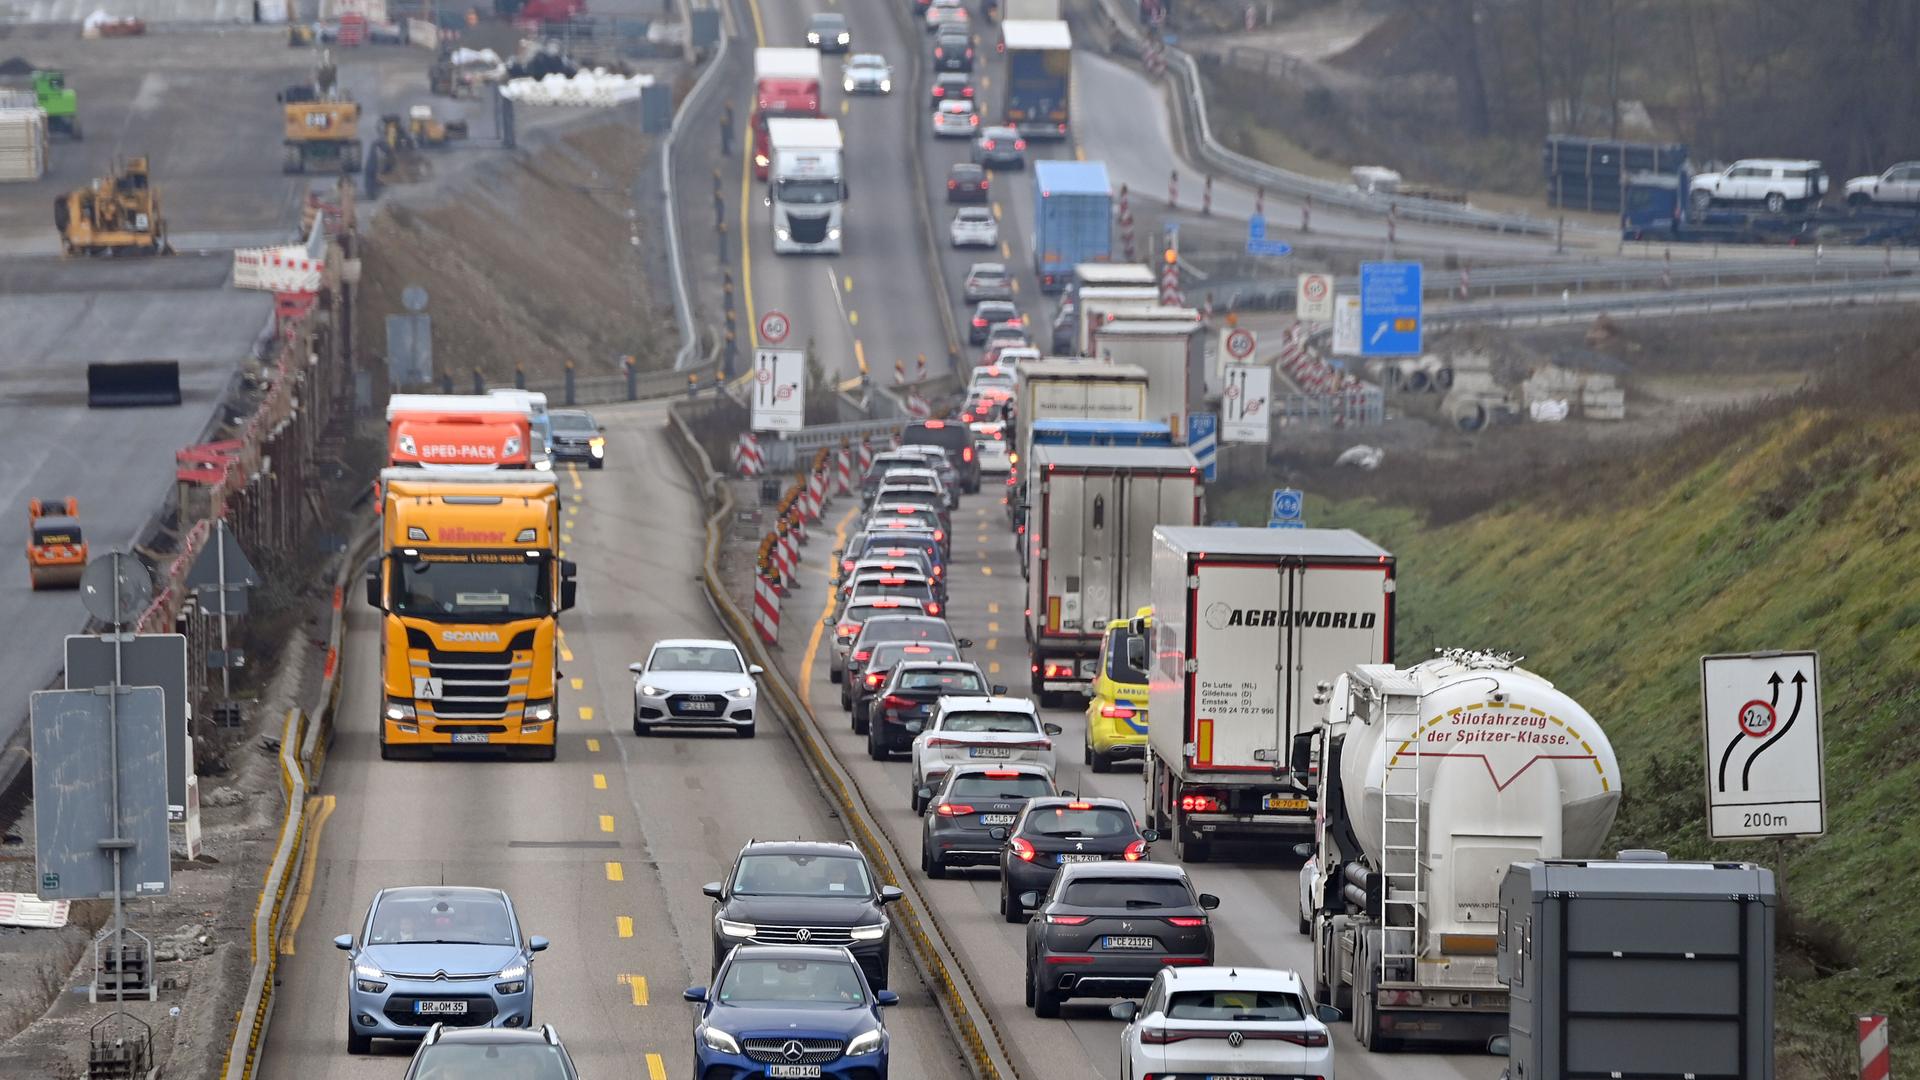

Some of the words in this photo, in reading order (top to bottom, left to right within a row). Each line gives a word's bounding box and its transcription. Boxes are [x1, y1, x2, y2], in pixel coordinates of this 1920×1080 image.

[442, 630, 499, 643] SCANIA
[422, 680, 435, 697] A
[1202, 681, 1212, 689] De
[1452, 712, 1548, 729] Silofahrzeug
[1427, 730, 1451, 742] der
[1456, 729, 1570, 745] Spitzer-Klasse.
[1743, 812, 1788, 828] 200m
[1117, 936, 1127, 946] CE
[422, 1001, 434, 1011] BR
[439, 1002, 451, 1011] OM
[453, 1002, 464, 1011] 35
[803, 1066, 820, 1076] 140
